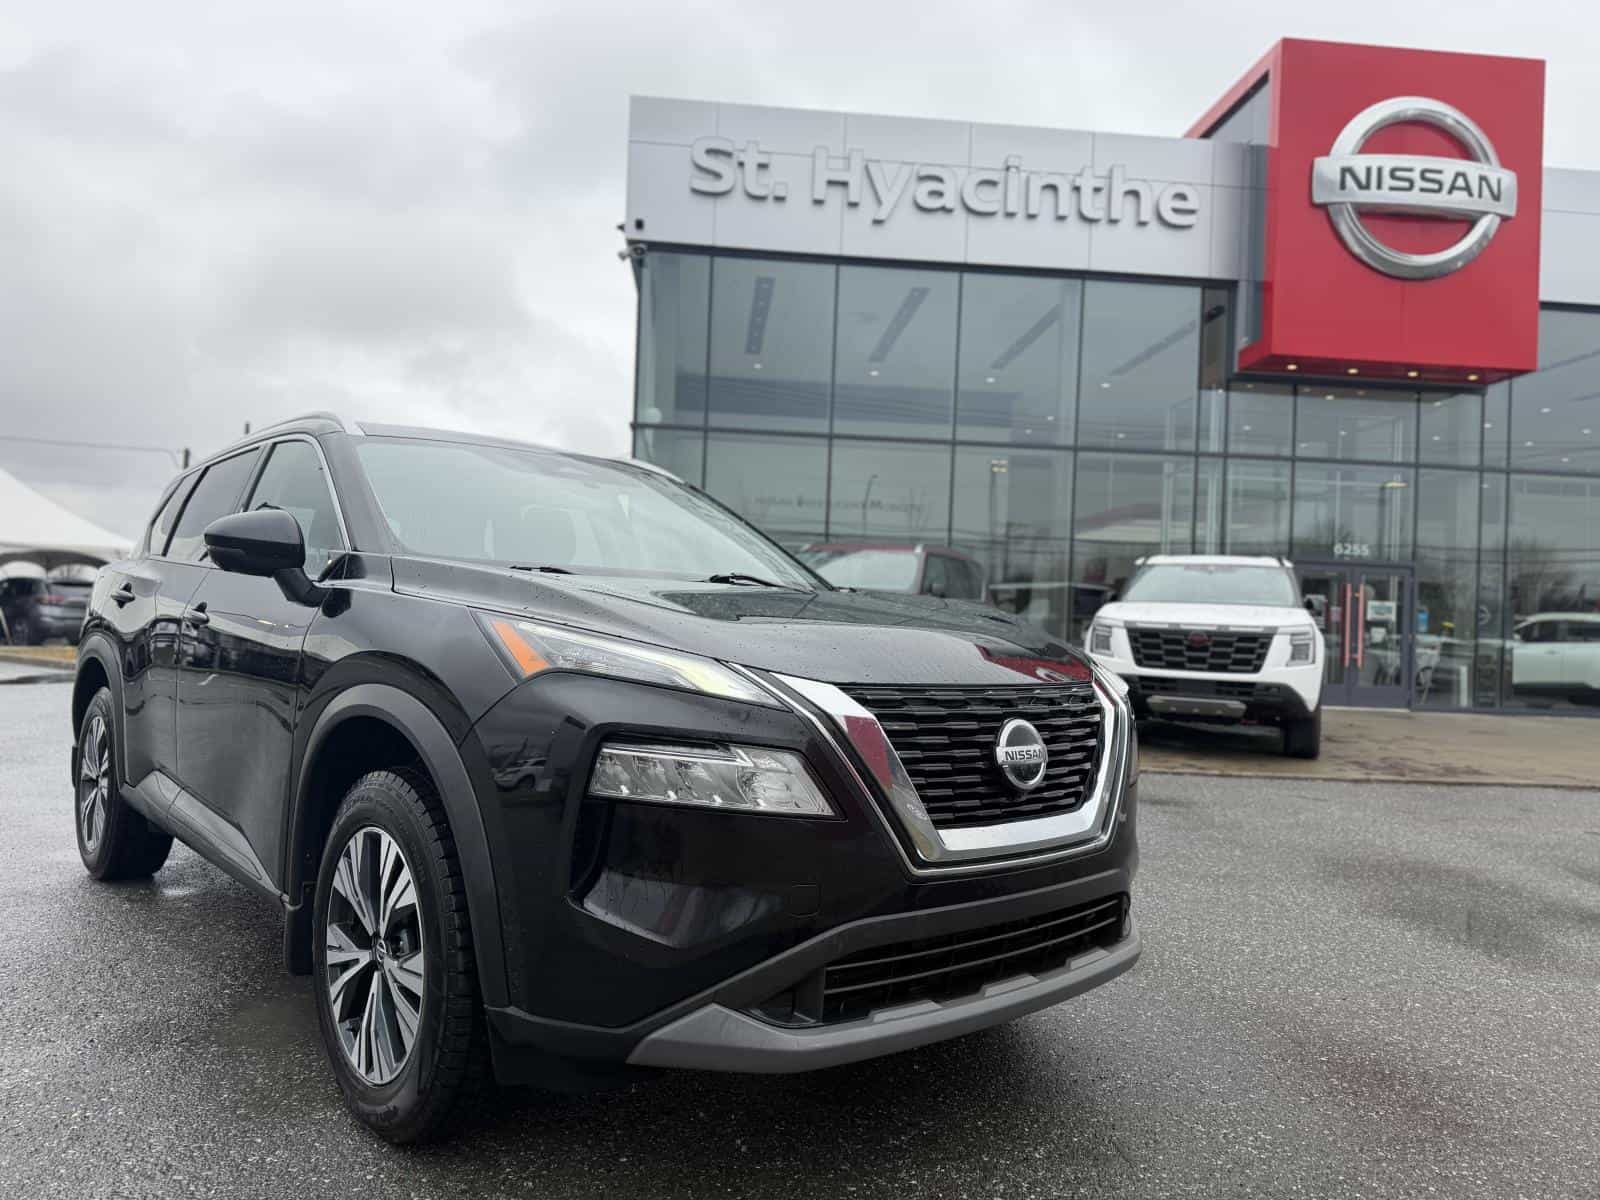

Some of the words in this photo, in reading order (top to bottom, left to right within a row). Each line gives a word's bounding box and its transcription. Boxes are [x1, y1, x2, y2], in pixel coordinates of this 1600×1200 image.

[690, 137, 787, 201] St.
[812, 146, 1198, 228] Hyacinthe
[1339, 166, 1501, 202] NISSAN
